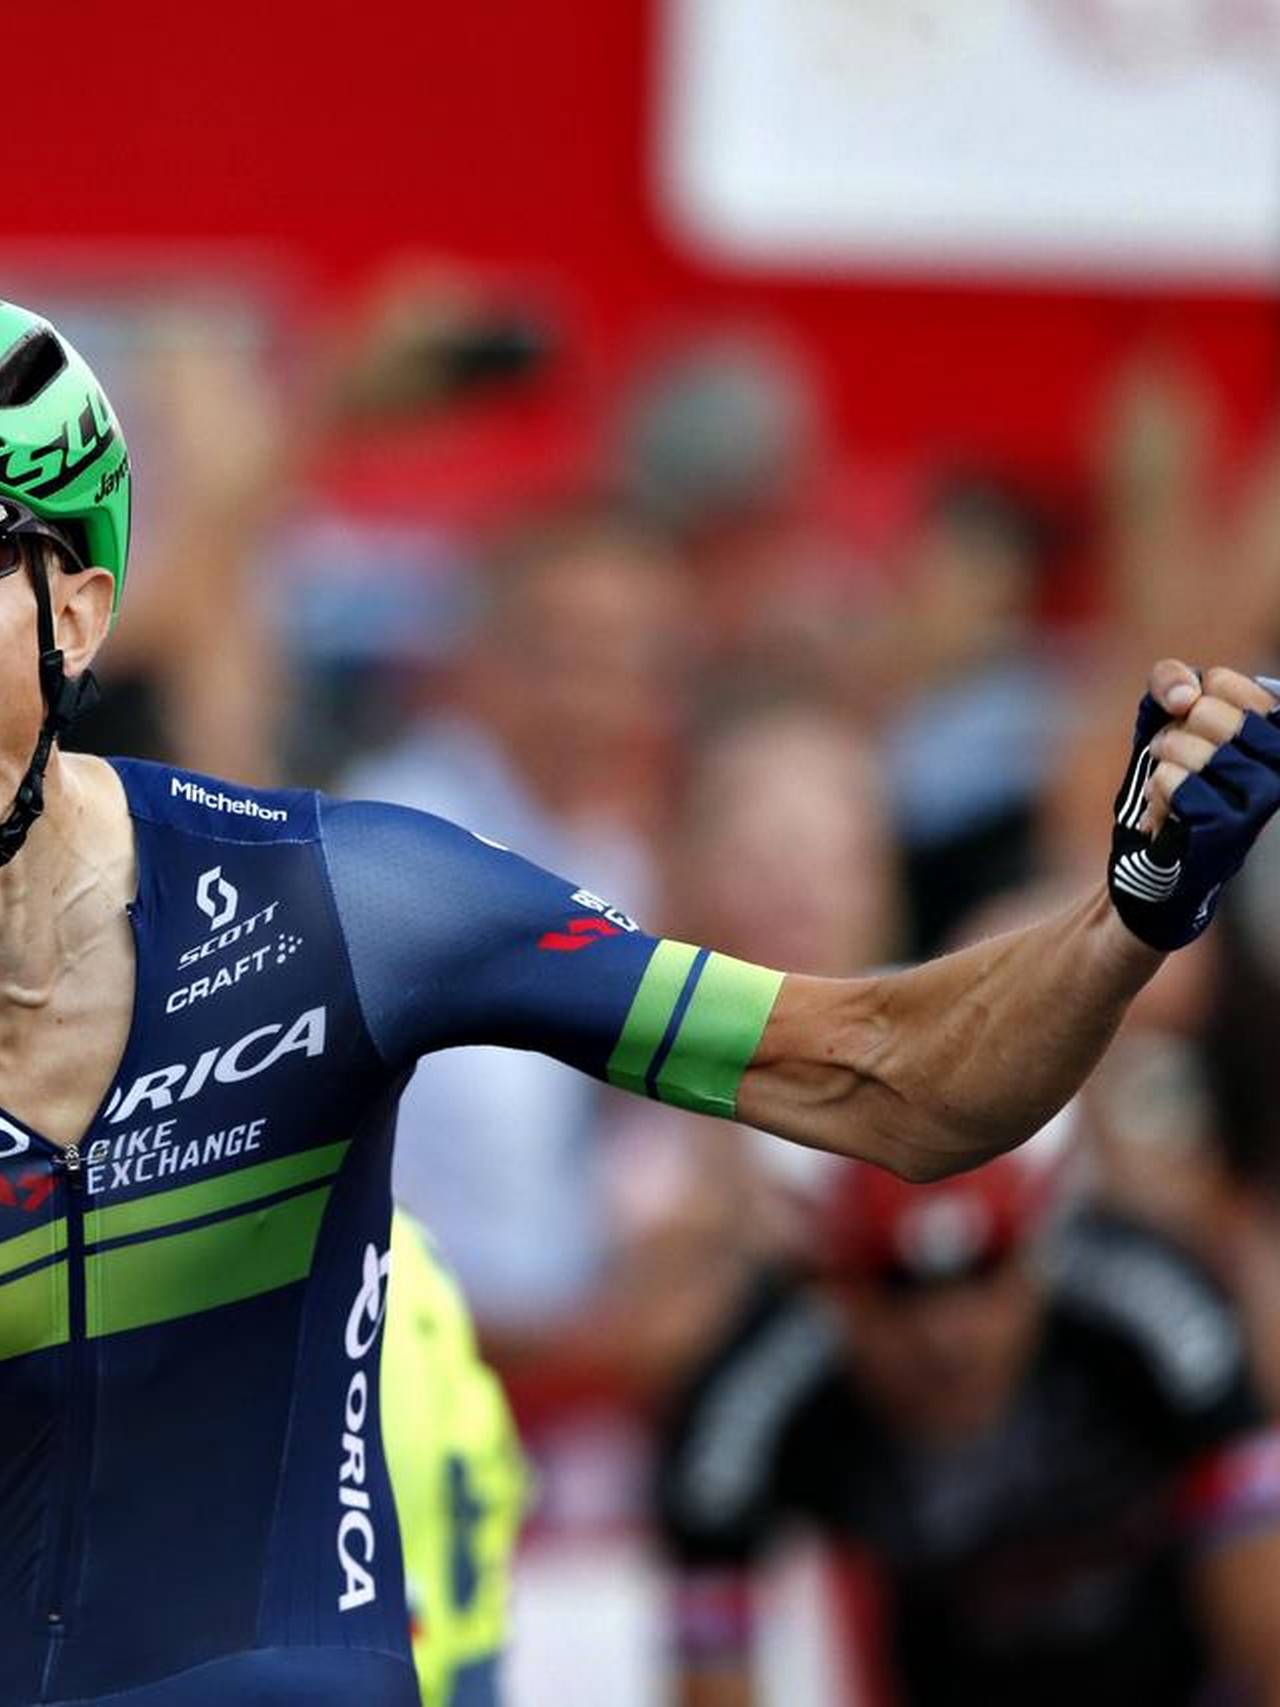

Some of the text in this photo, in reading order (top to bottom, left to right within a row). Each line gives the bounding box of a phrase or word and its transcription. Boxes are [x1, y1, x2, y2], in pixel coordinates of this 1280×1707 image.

[94, 451, 129, 504] Jayc
[170, 777, 288, 822] Mitchelton
[176, 901, 280, 971] SCOTT
[165, 944, 271, 1014] CRAFT
[86, 1118, 269, 1195] EXCHANGE
[87, 1119, 178, 1166] BIKE
[337, 1371, 377, 1613] ORICA
